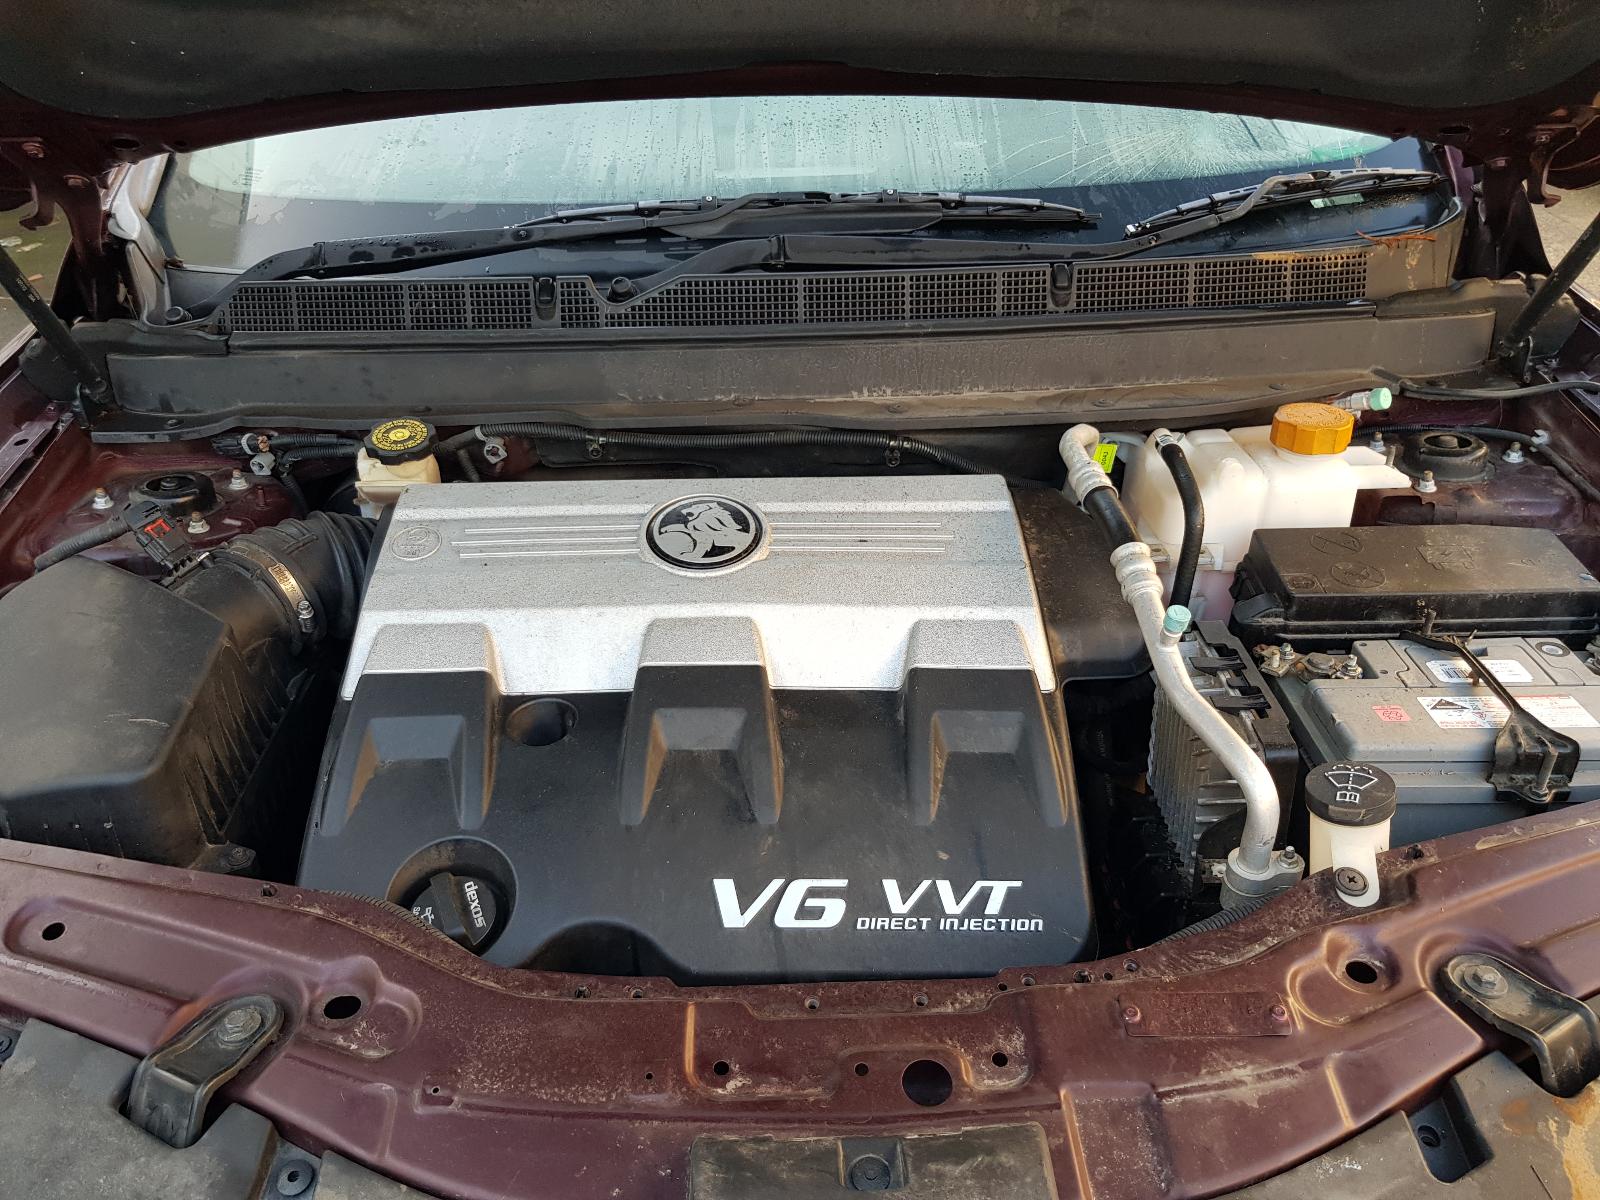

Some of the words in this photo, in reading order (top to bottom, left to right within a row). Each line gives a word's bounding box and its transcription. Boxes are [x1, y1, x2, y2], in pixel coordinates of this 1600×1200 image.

[464, 880, 487, 929] dexos
[712, 878, 849, 928] V6
[881, 879, 1023, 915] VVT
[856, 917, 931, 931] DIRECT
[939, 918, 1044, 932] INJECTION
